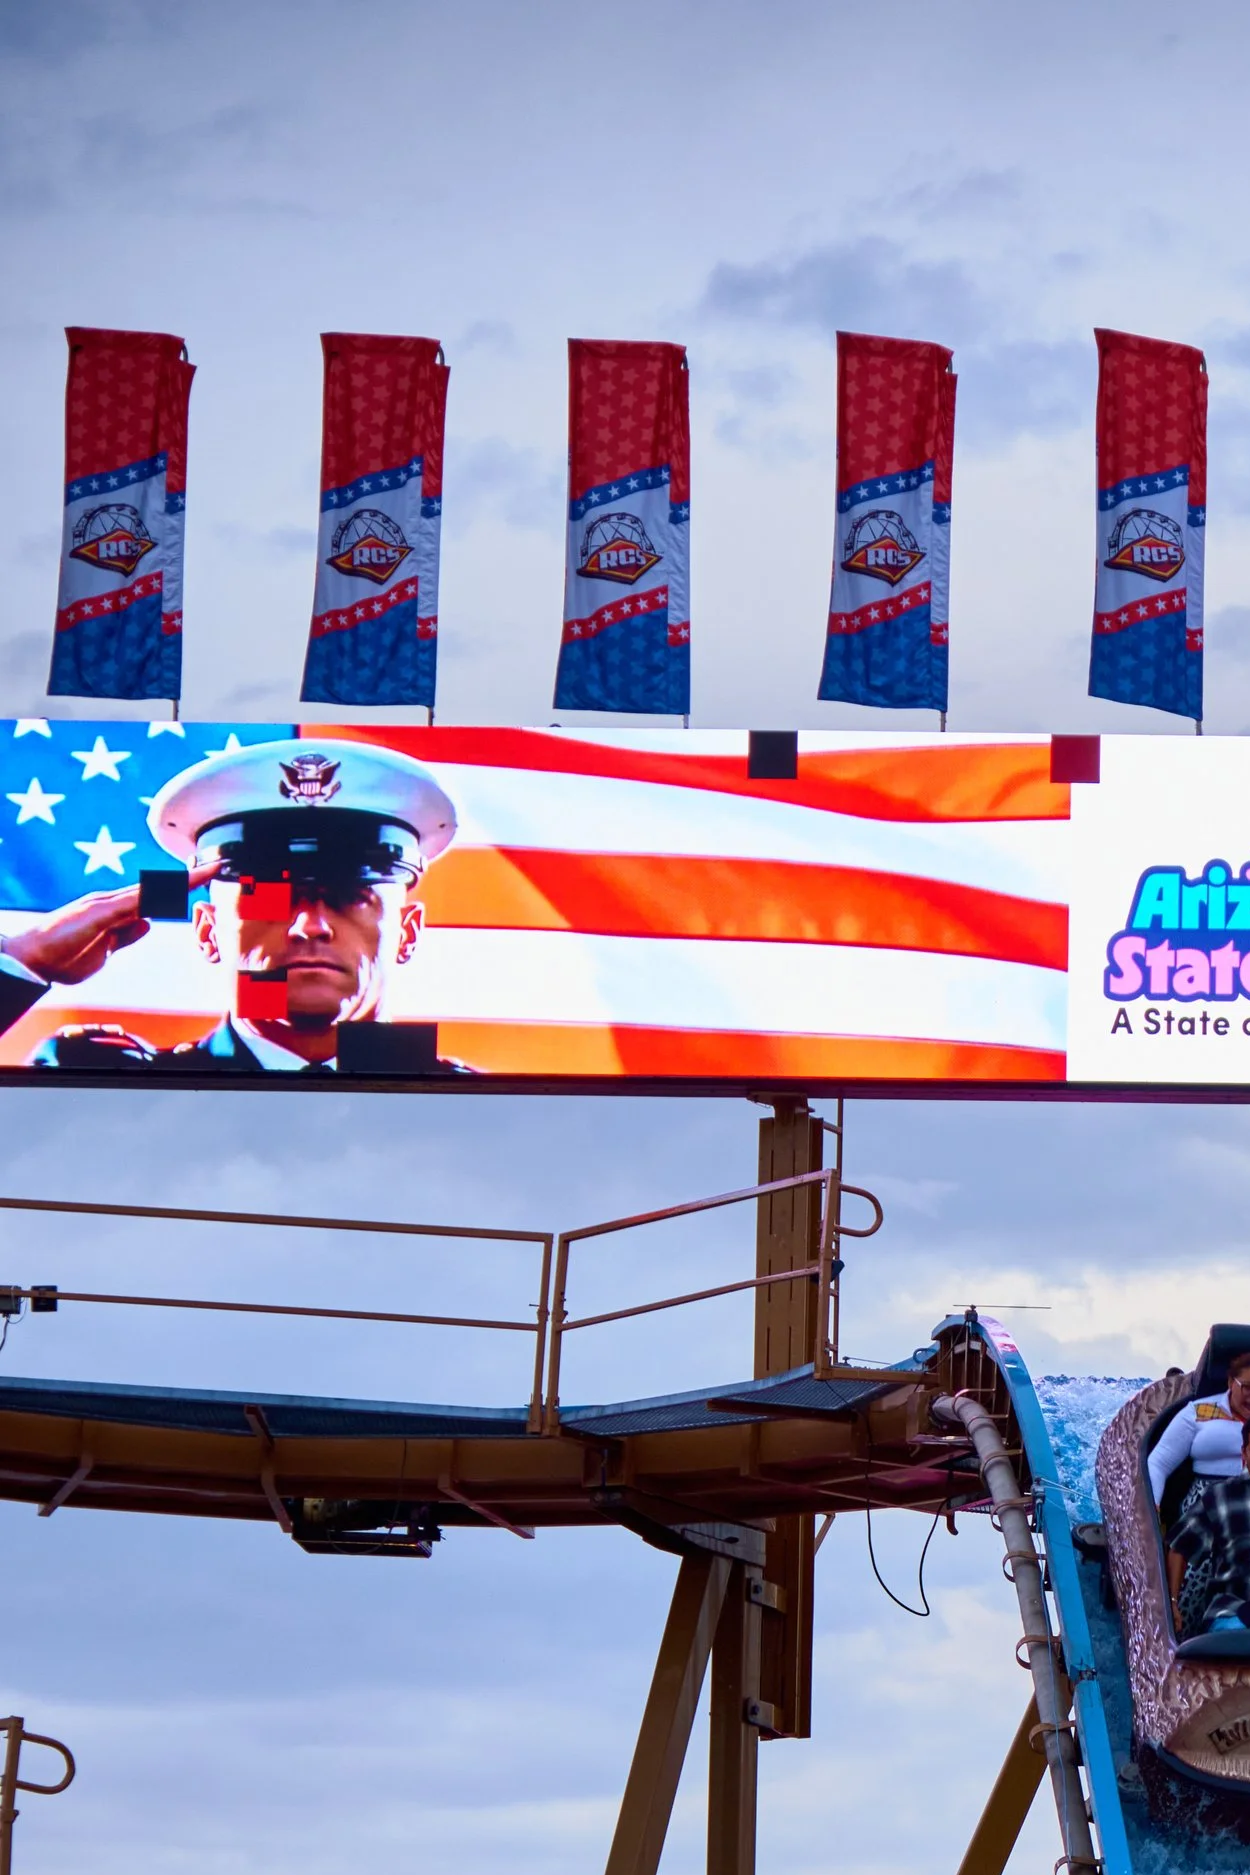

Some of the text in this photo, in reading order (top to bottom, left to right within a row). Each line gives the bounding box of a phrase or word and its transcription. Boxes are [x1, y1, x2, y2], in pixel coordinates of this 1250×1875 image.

[352, 547, 401, 566] RCS
[599, 549, 647, 569] RCS
[866, 548, 912, 566] RCS
[1132, 545, 1181, 563] RCS
[1110, 1007, 1133, 1035] A
[1143, 1008, 1230, 1036] State
